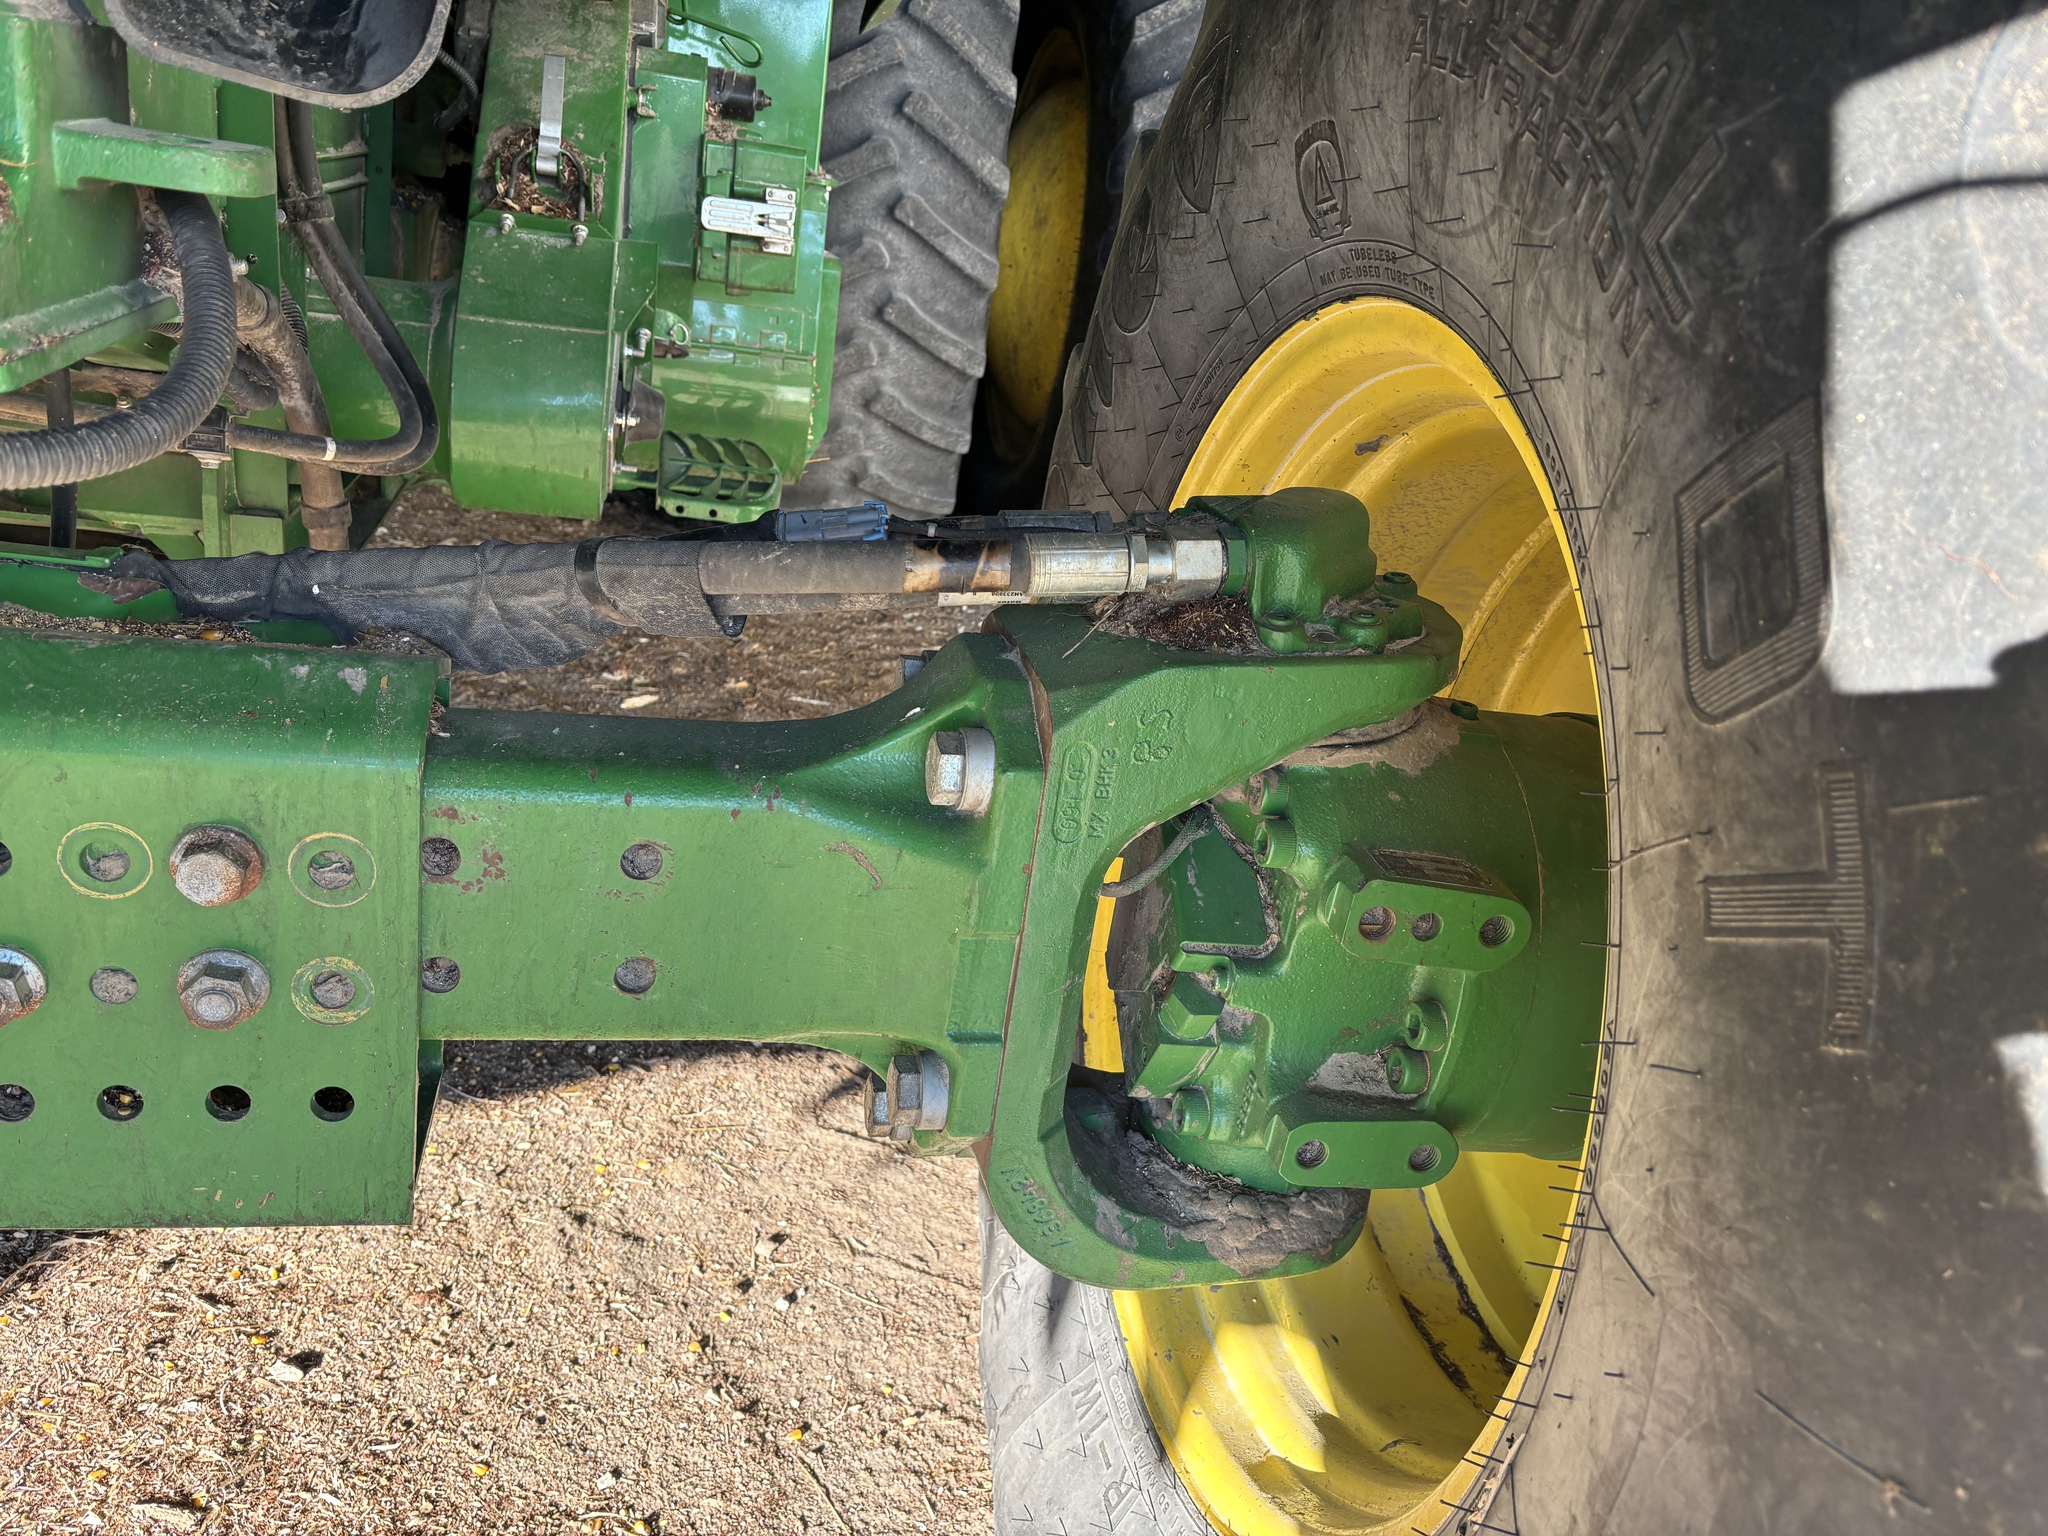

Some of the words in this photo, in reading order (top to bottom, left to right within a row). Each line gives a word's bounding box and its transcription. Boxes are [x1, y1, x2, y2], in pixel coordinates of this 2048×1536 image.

[1405, 15, 1467, 82] ALL
[1477, 37, 1657, 358] TRACTION
[1348, 247, 1397, 264] TUBELESS
[1319, 270, 1336, 287] MAY
[1339, 266, 1353, 280] BE
[1355, 265, 1381, 279] USED
[1385, 267, 1409, 286] TUBE
[1412, 276, 1436, 300] TYPE
